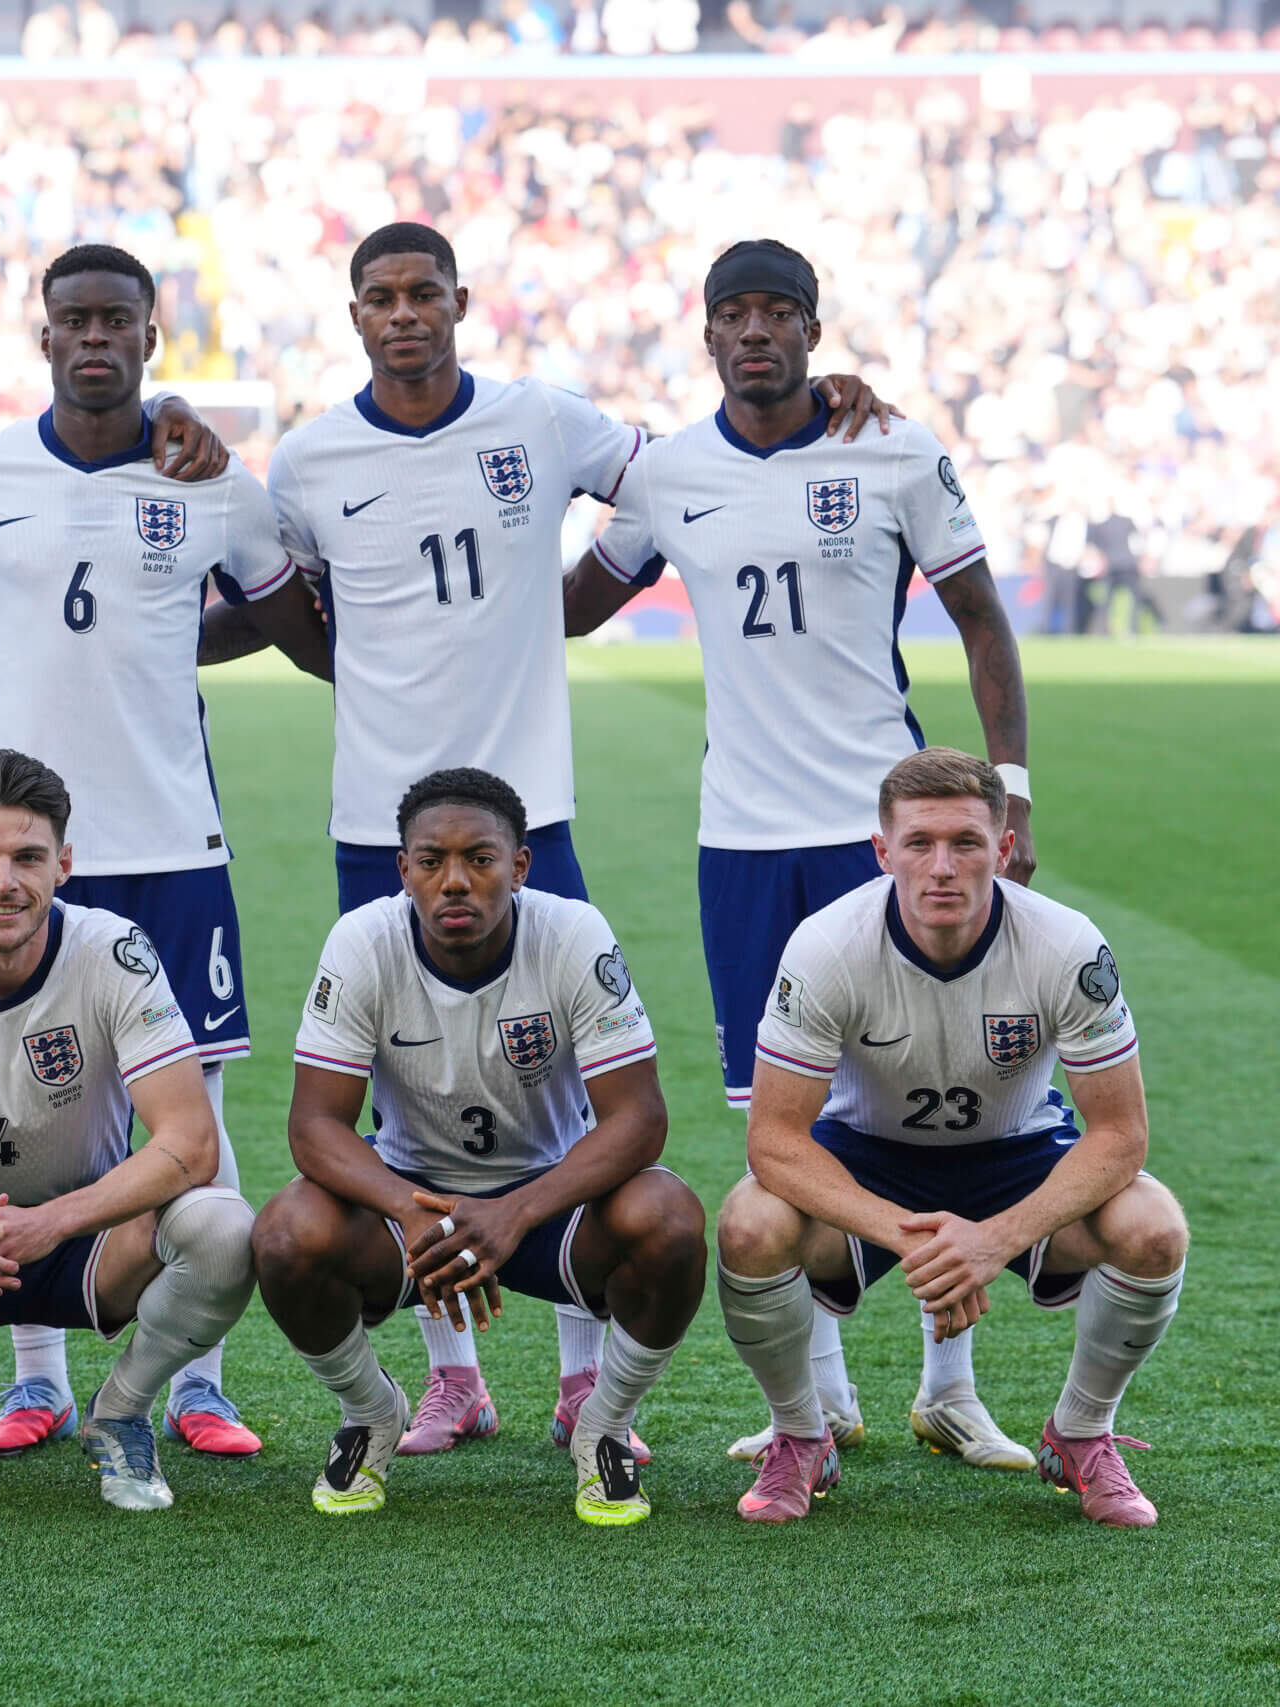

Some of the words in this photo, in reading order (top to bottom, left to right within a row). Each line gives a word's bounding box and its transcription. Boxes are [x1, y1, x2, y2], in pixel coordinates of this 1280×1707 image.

[498, 504, 531, 518] ANDORRA
[502, 515, 530, 529] 06.09.25
[818, 537, 855, 547] ANDORRA
[141, 552, 177, 563] ANDORRA
[821, 548, 853, 559] 06.09.25
[143, 562, 173, 574] 06.09.25
[420, 528, 484, 605] 11
[64, 561, 96, 634] 6
[737, 562, 806, 639] 21
[208, 926, 234, 1000] 6
[519, 1064, 553, 1082] ANDORRA
[48, 1085, 83, 1102] ANDORRA
[902, 1087, 982, 1132] 23
[460, 1105, 498, 1156] 3
